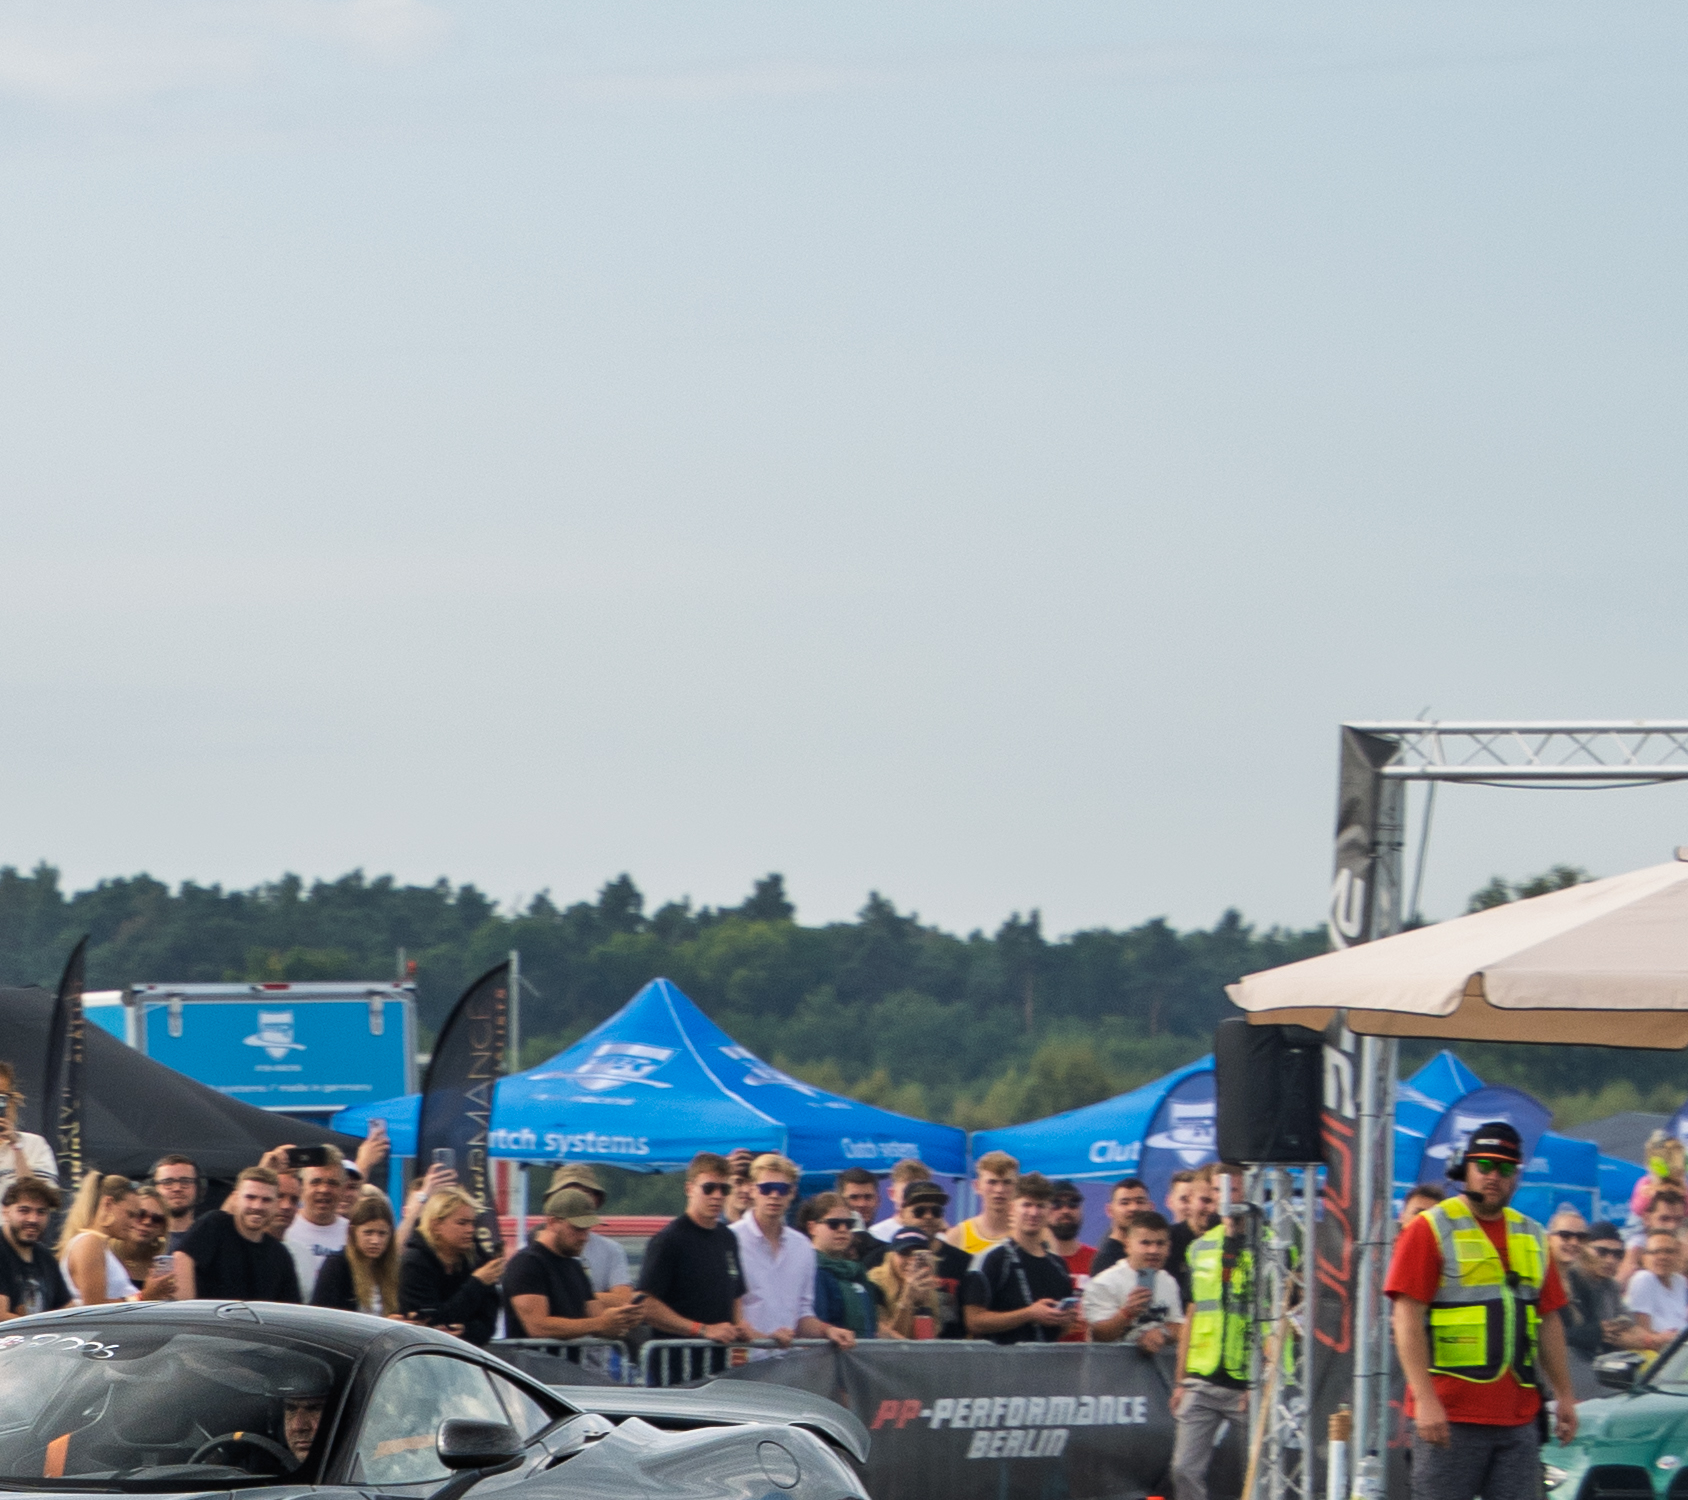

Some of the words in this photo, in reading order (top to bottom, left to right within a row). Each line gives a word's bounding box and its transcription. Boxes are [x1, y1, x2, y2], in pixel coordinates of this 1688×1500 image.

[488, 1128, 537, 1150] tch
[544, 1132, 650, 1158] systems
[965, 1428, 1070, 1459] BERLIN
